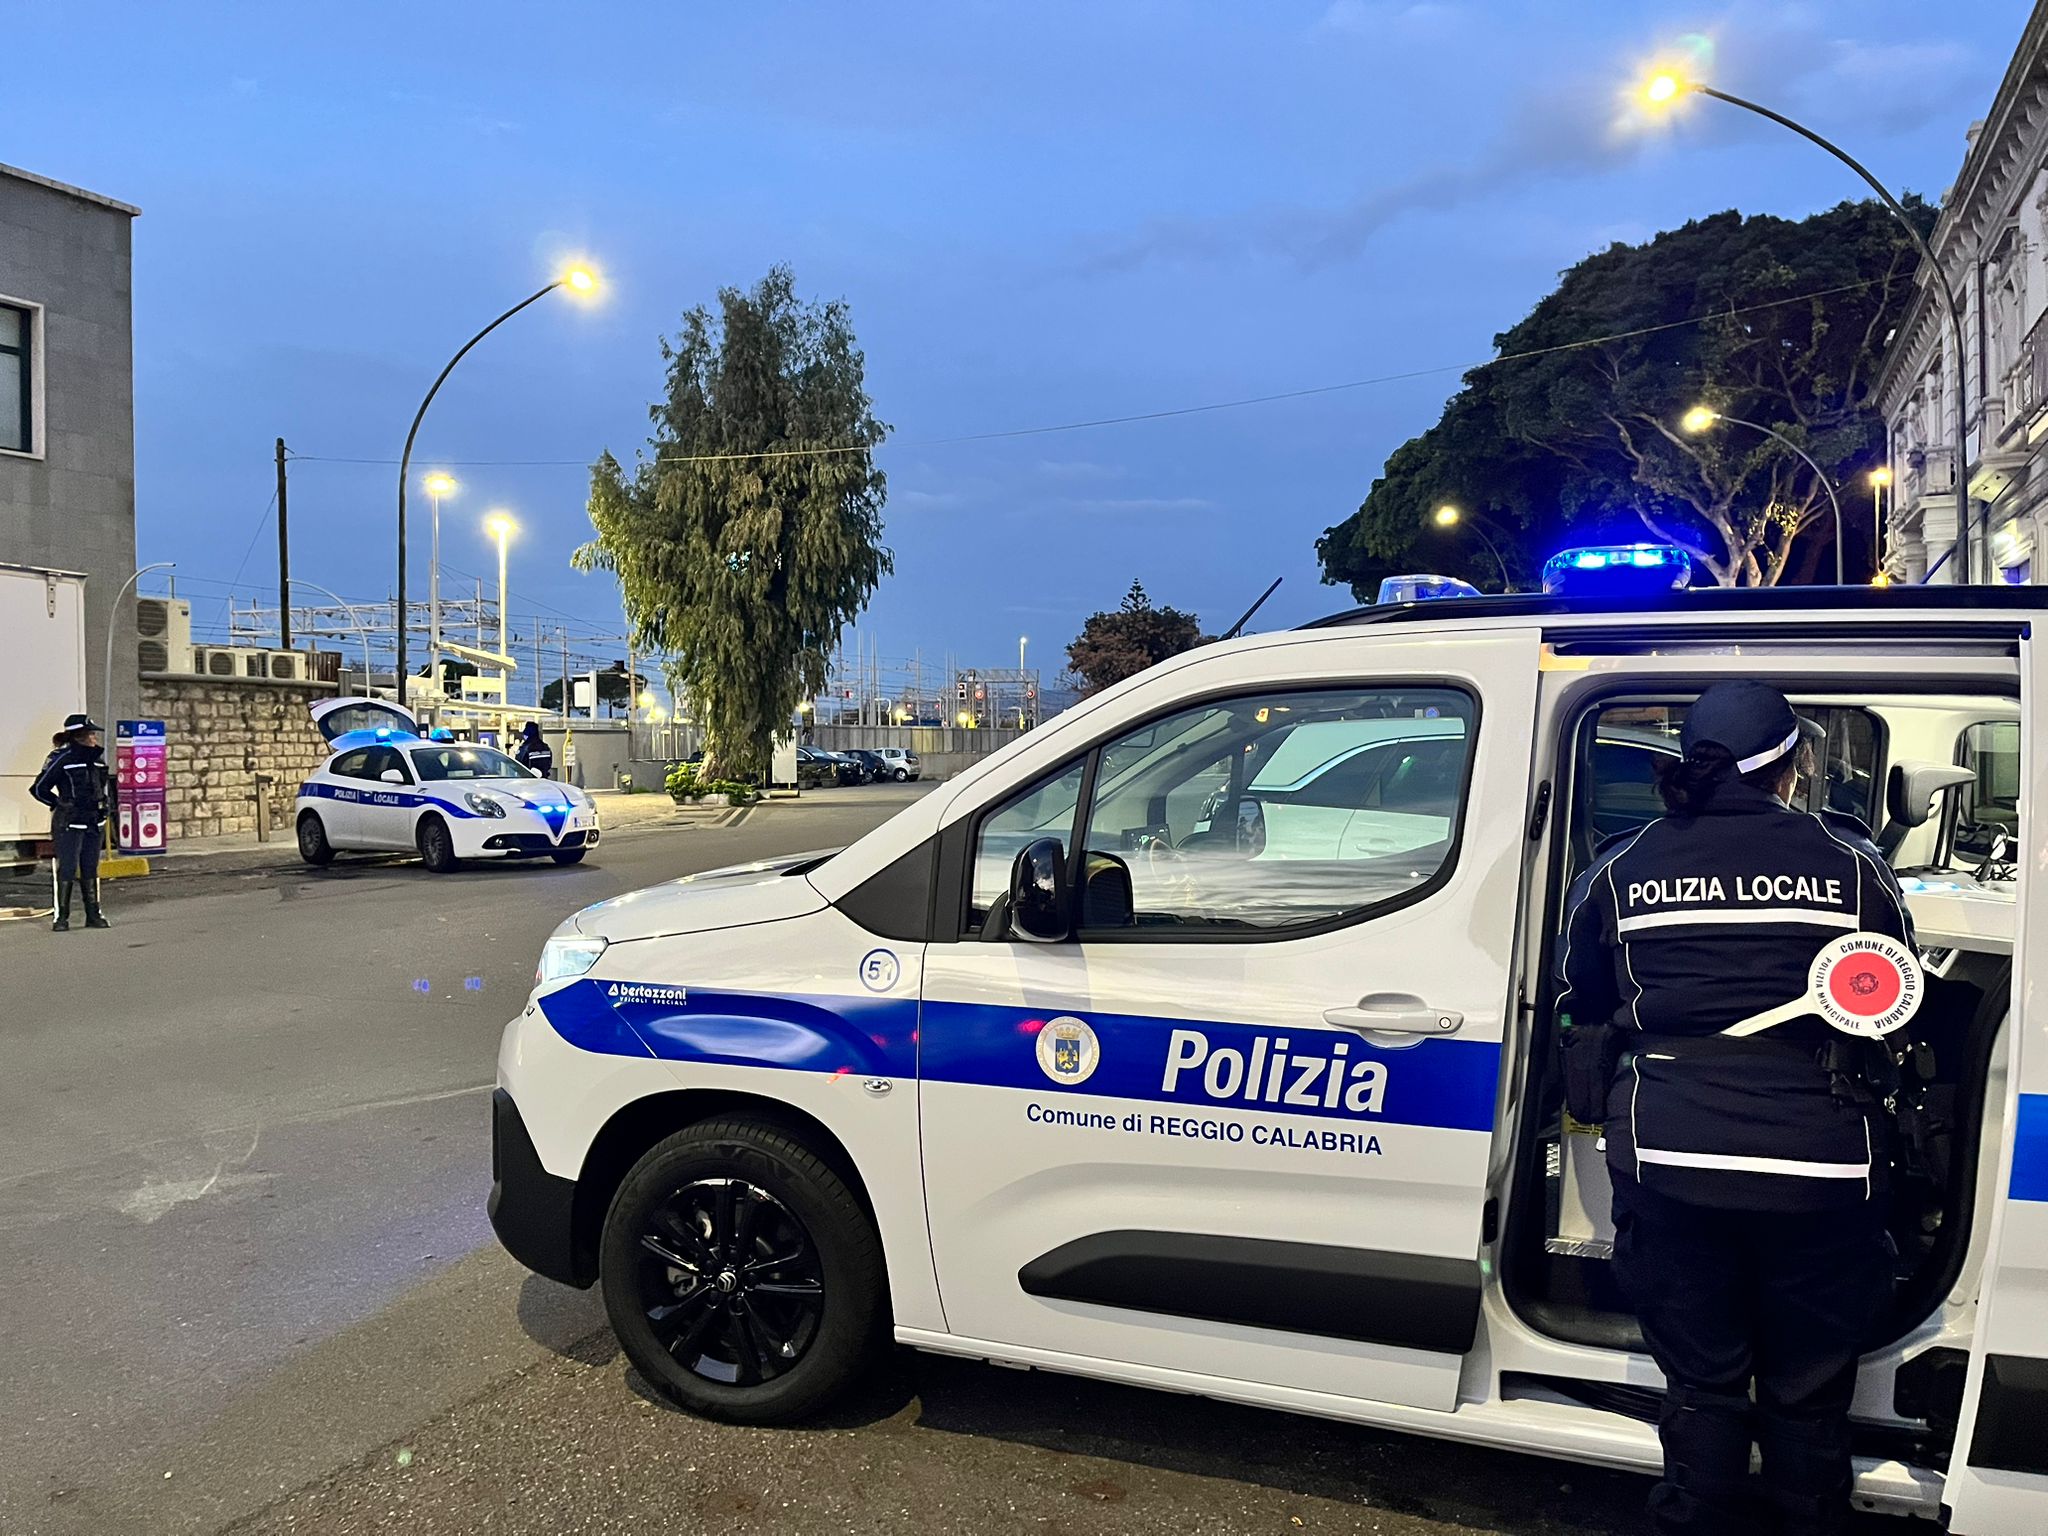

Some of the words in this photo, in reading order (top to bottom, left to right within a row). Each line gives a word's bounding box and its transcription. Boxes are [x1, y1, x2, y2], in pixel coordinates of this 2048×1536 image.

[334, 788, 357, 800] POLIZIA
[374, 793, 399, 805] LOCALE
[1628, 876, 1726, 907] POLIZIA
[1736, 875, 1843, 904] LOCALE
[1840, 940, 1885, 954] COMUNE
[1885, 946, 1898, 959] DI
[868, 960, 893, 981] 51
[1815, 957, 1832, 988] POLIZIA
[1895, 956, 1916, 990] REGGIO
[620, 983, 687, 1000] bertazzoni
[653, 998, 687, 1006] SPECIALI
[1817, 992, 1861, 1030] MUNICIPALE
[1874, 993, 1914, 1029] CALABRIA
[1161, 1029, 1388, 1114] Polizia
[1026, 1103, 1117, 1130] Comune
[1122, 1113, 1143, 1134] di
[1150, 1115, 1244, 1143] REGGIO
[1251, 1125, 1383, 1156] CALABRIA
